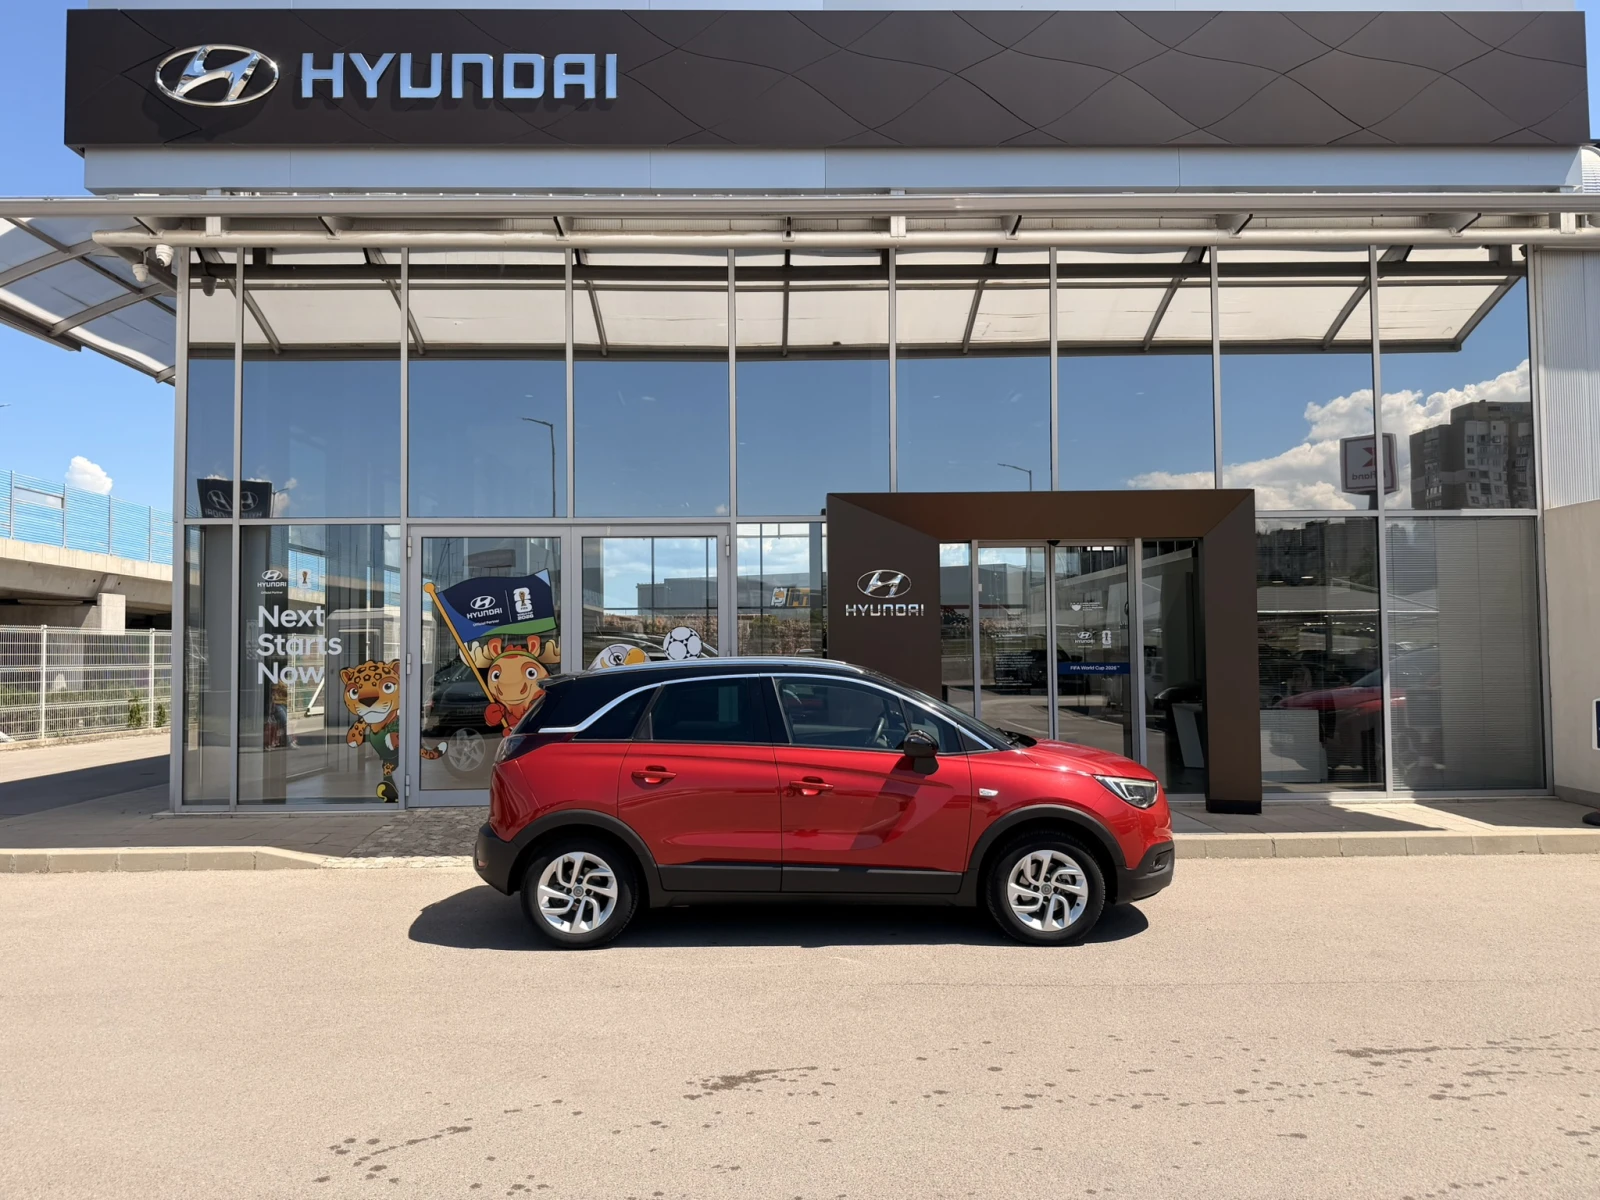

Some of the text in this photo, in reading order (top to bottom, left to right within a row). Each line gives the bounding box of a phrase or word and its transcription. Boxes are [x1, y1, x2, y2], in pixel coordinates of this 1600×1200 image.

[301, 52, 617, 99] HYUNDAI
[258, 605, 325, 628] Next
[466, 608, 503, 619] HYUNDAI
[845, 604, 924, 617] HYUNDAI
[256, 633, 343, 656] Starts
[257, 661, 325, 685] Now
